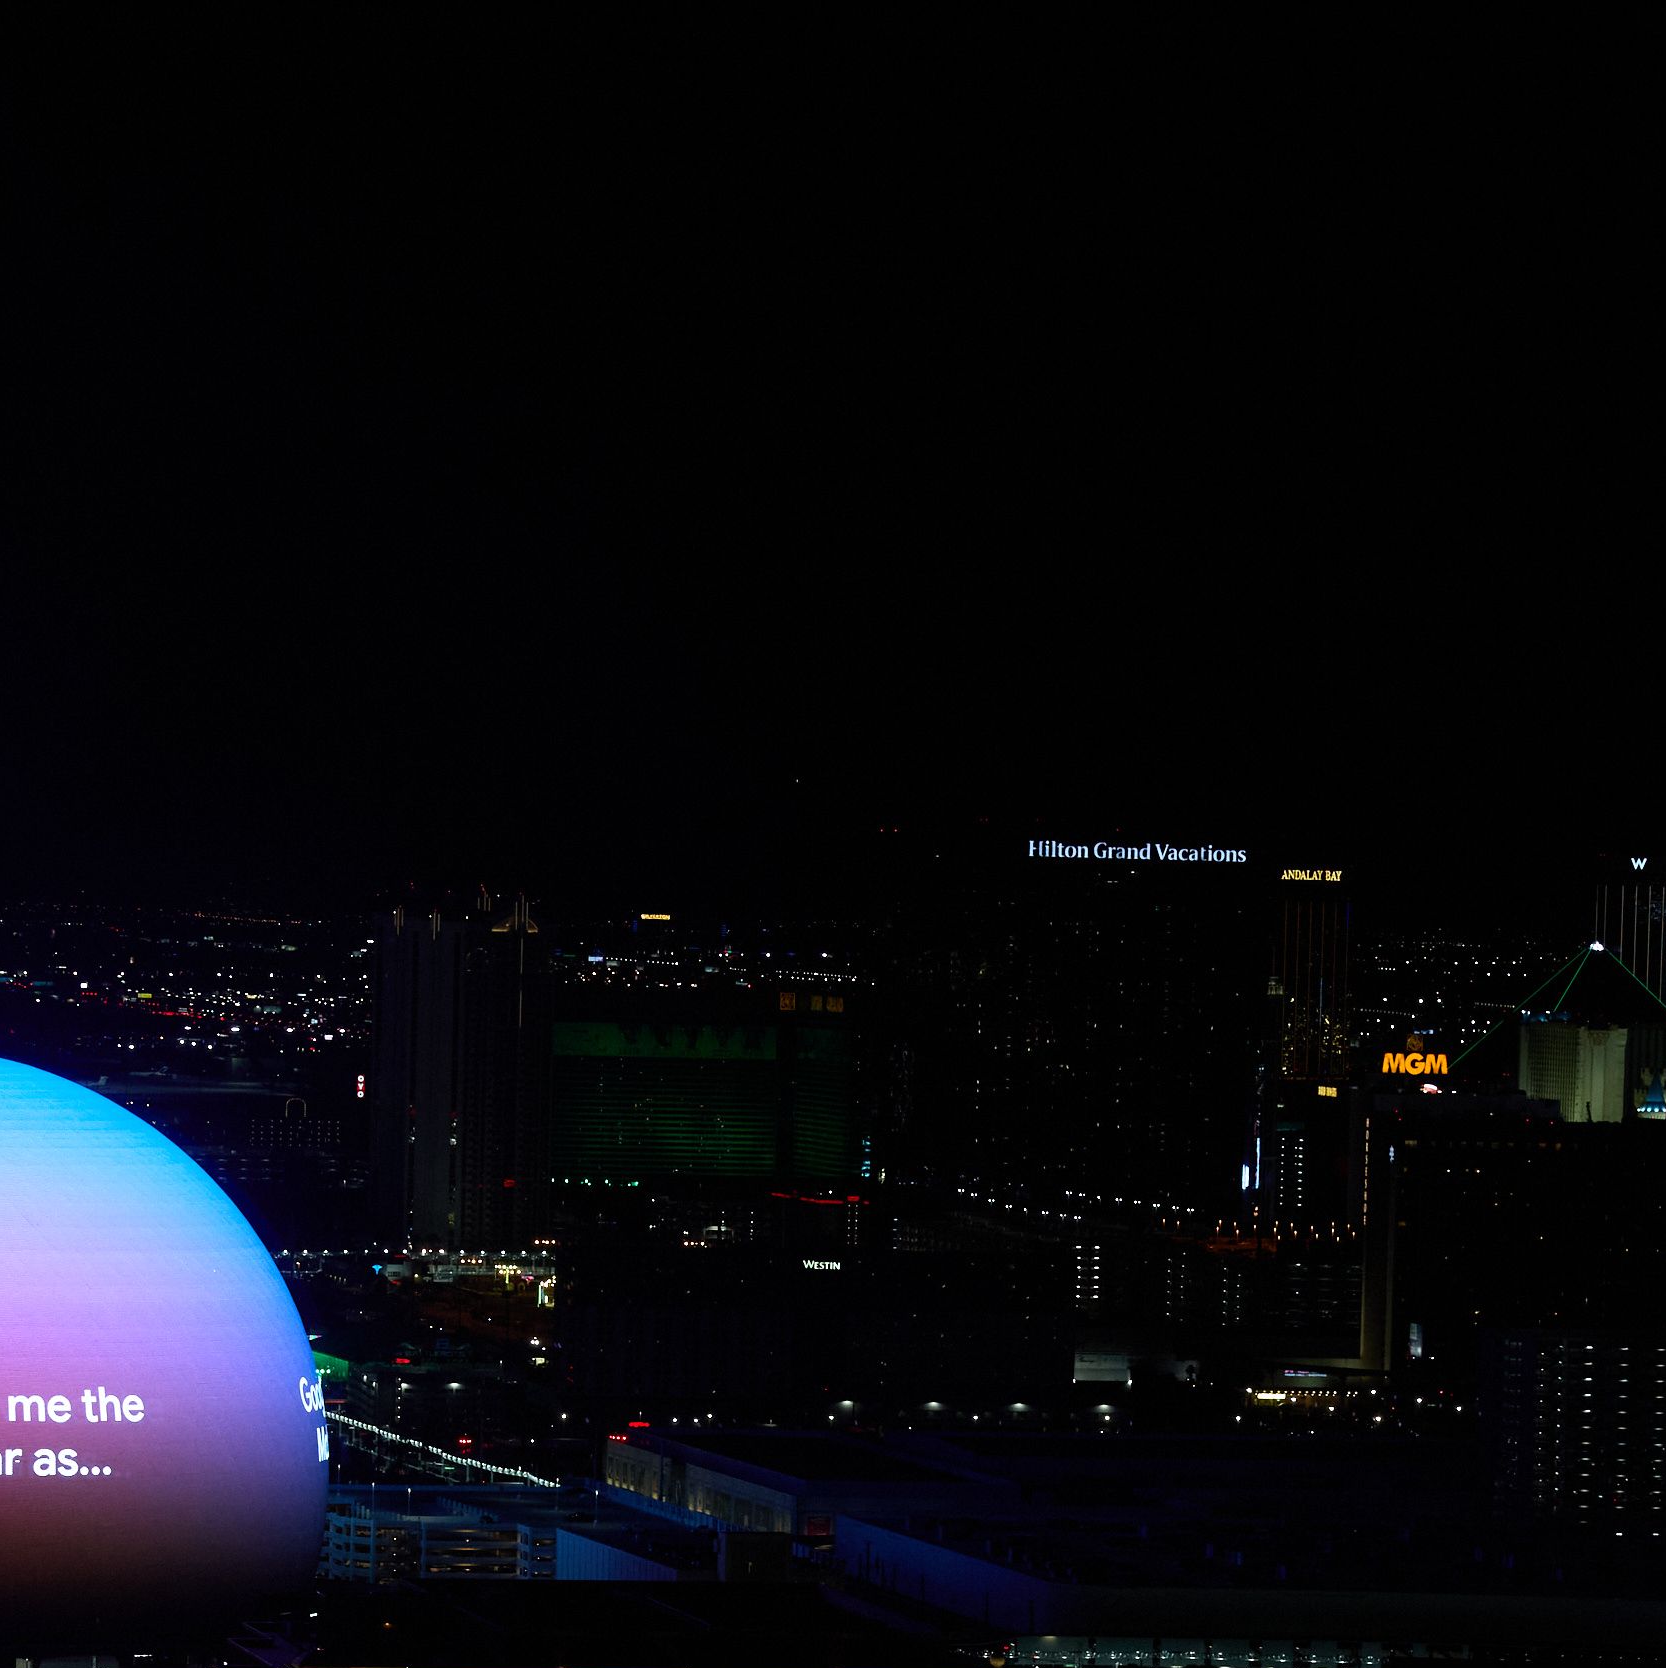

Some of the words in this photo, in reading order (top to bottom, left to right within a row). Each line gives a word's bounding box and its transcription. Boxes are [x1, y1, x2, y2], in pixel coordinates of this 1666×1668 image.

[1029, 840, 1089, 859] Hilton
[1093, 841, 1151, 860] Grand
[1155, 843, 1247, 863] Vacations
[1630, 857, 1648, 870] W
[1281, 869, 1324, 881] ANDALAY
[1325, 870, 1342, 882] BAY
[1382, 1052, 1448, 1076] MGM
[357, 1075, 365, 1098] OYO
[802, 1259, 841, 1271] WESTIN
[7, 1395, 72, 1423] me
[81, 1386, 145, 1423] the
[33, 1448, 112, 1477] as...
